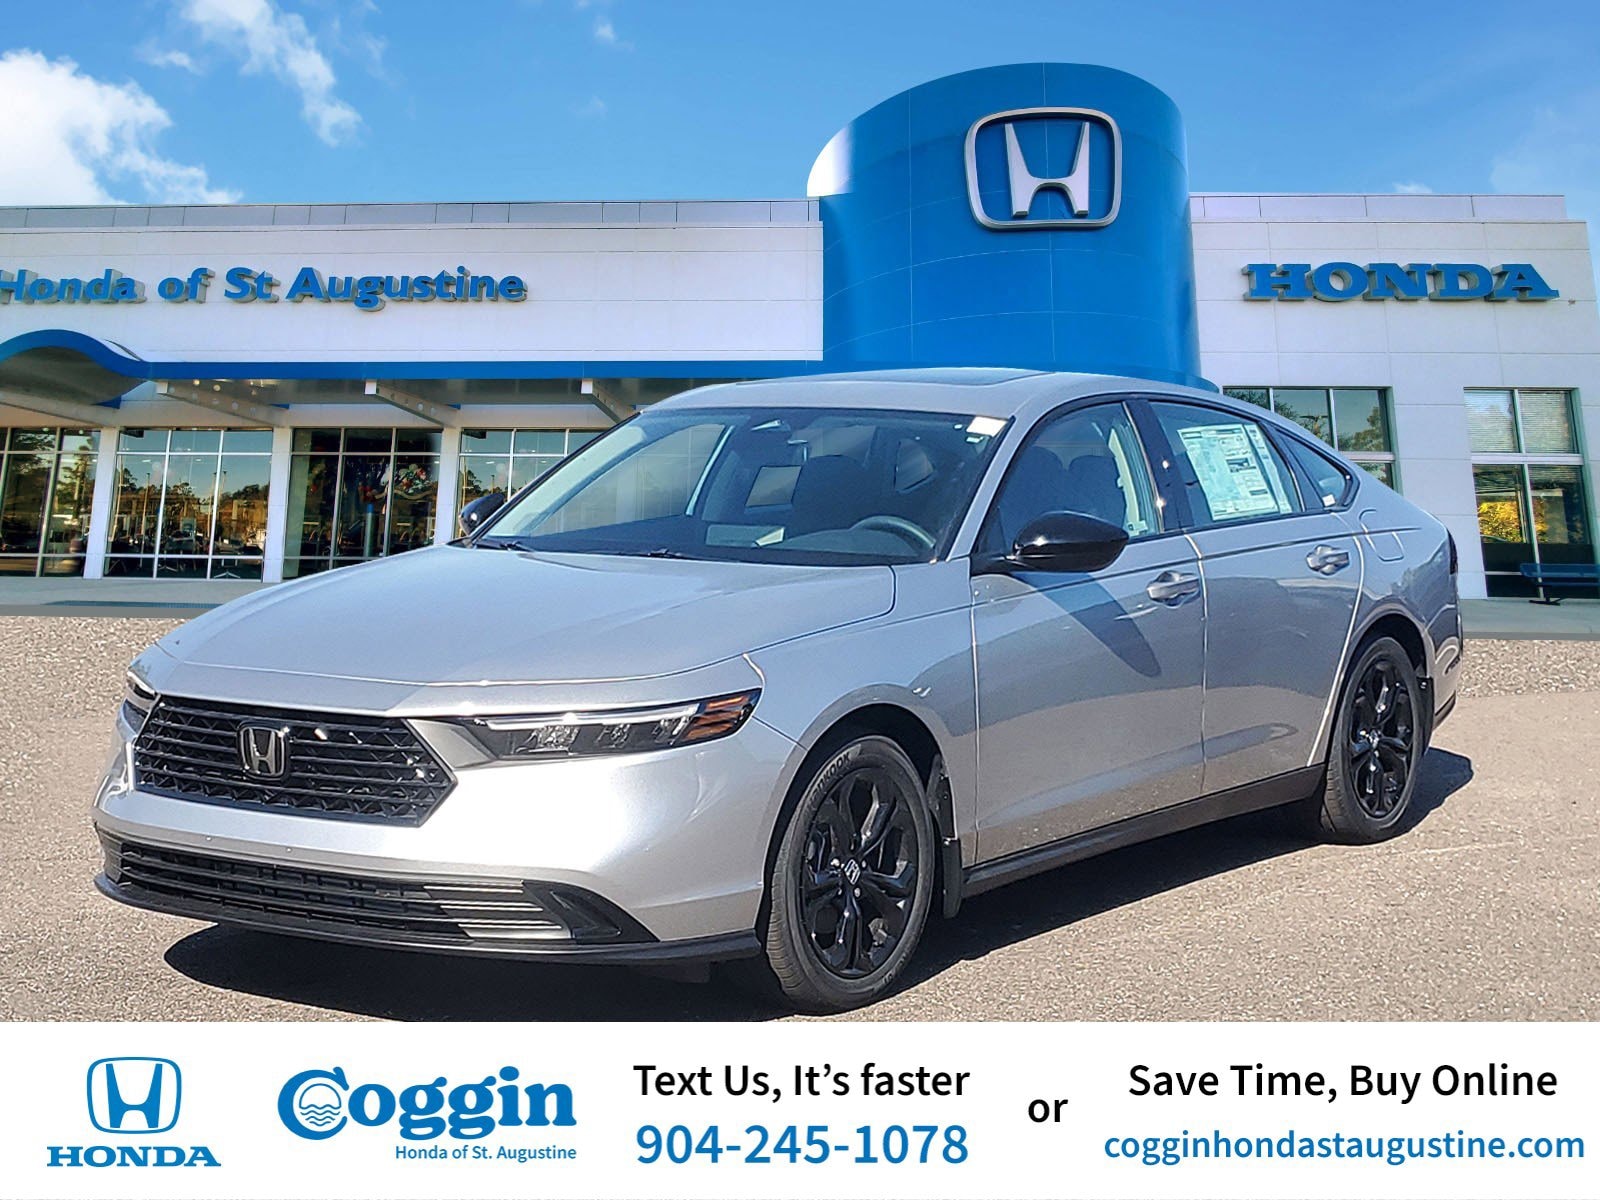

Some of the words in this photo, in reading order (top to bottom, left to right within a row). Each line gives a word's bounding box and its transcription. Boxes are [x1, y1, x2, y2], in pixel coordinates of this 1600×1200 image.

[0, 268, 144, 302] Honda
[158, 267, 213, 302] of
[225, 266, 277, 303] St
[286, 265, 526, 311] Augustine
[1244, 262, 1559, 301] HONDA
